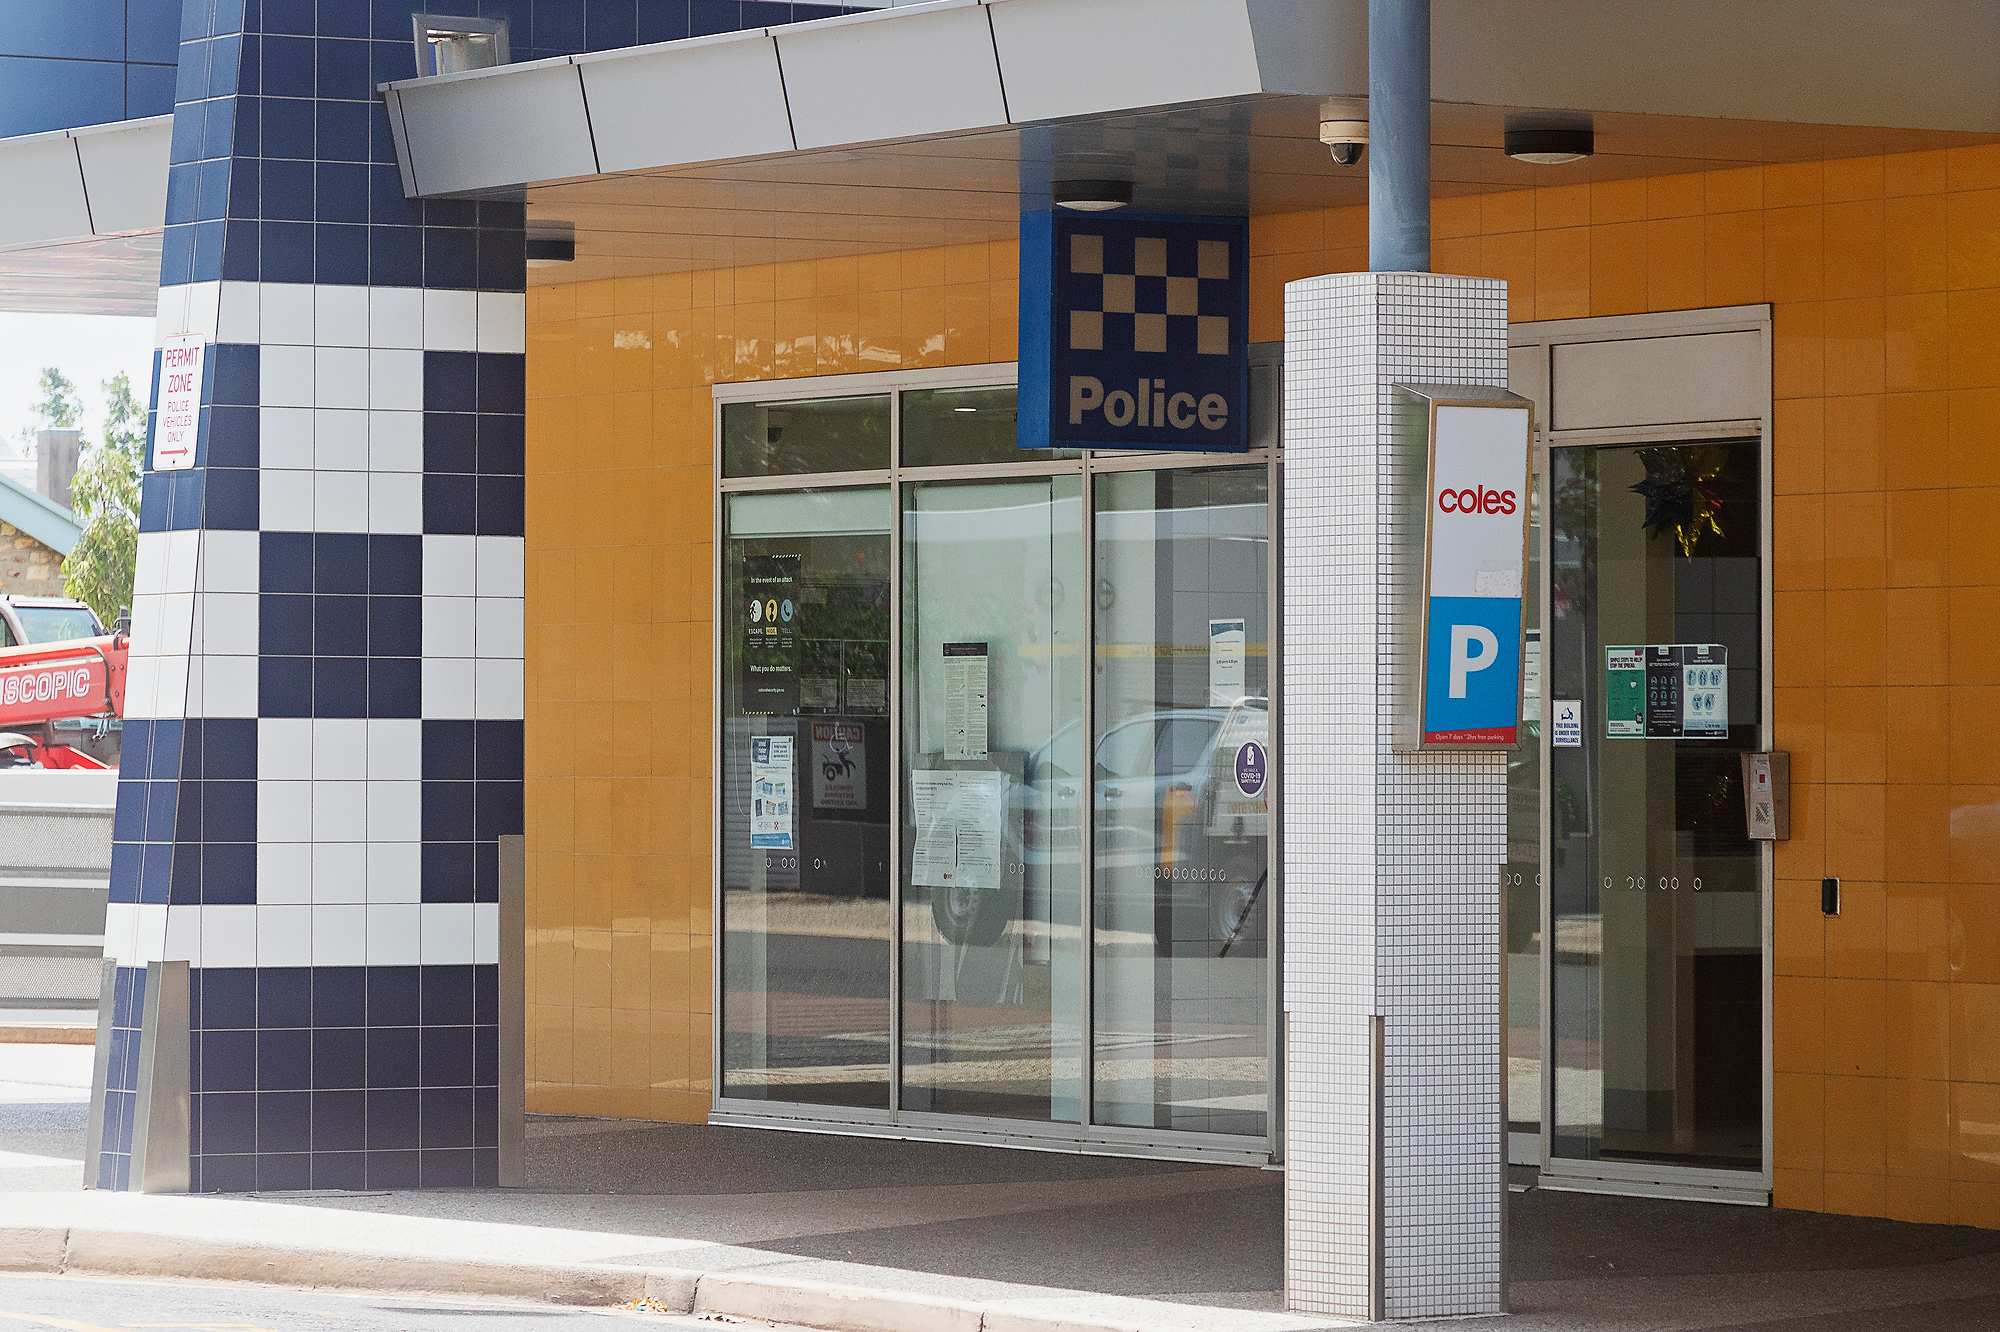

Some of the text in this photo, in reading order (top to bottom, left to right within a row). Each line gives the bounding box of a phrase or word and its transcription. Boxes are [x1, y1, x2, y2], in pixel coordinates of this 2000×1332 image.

[165, 346, 200, 369] PERMIT
[167, 373, 193, 394] ZONE
[167, 399, 190, 413] POLICE
[1069, 375, 1229, 431] Police
[162, 415, 193, 428] VEHICLES
[167, 431, 185, 443] ONLY
[1438, 484, 1517, 515] coles
[750, 664, 761, 672] What
[1448, 624, 1499, 699] P
